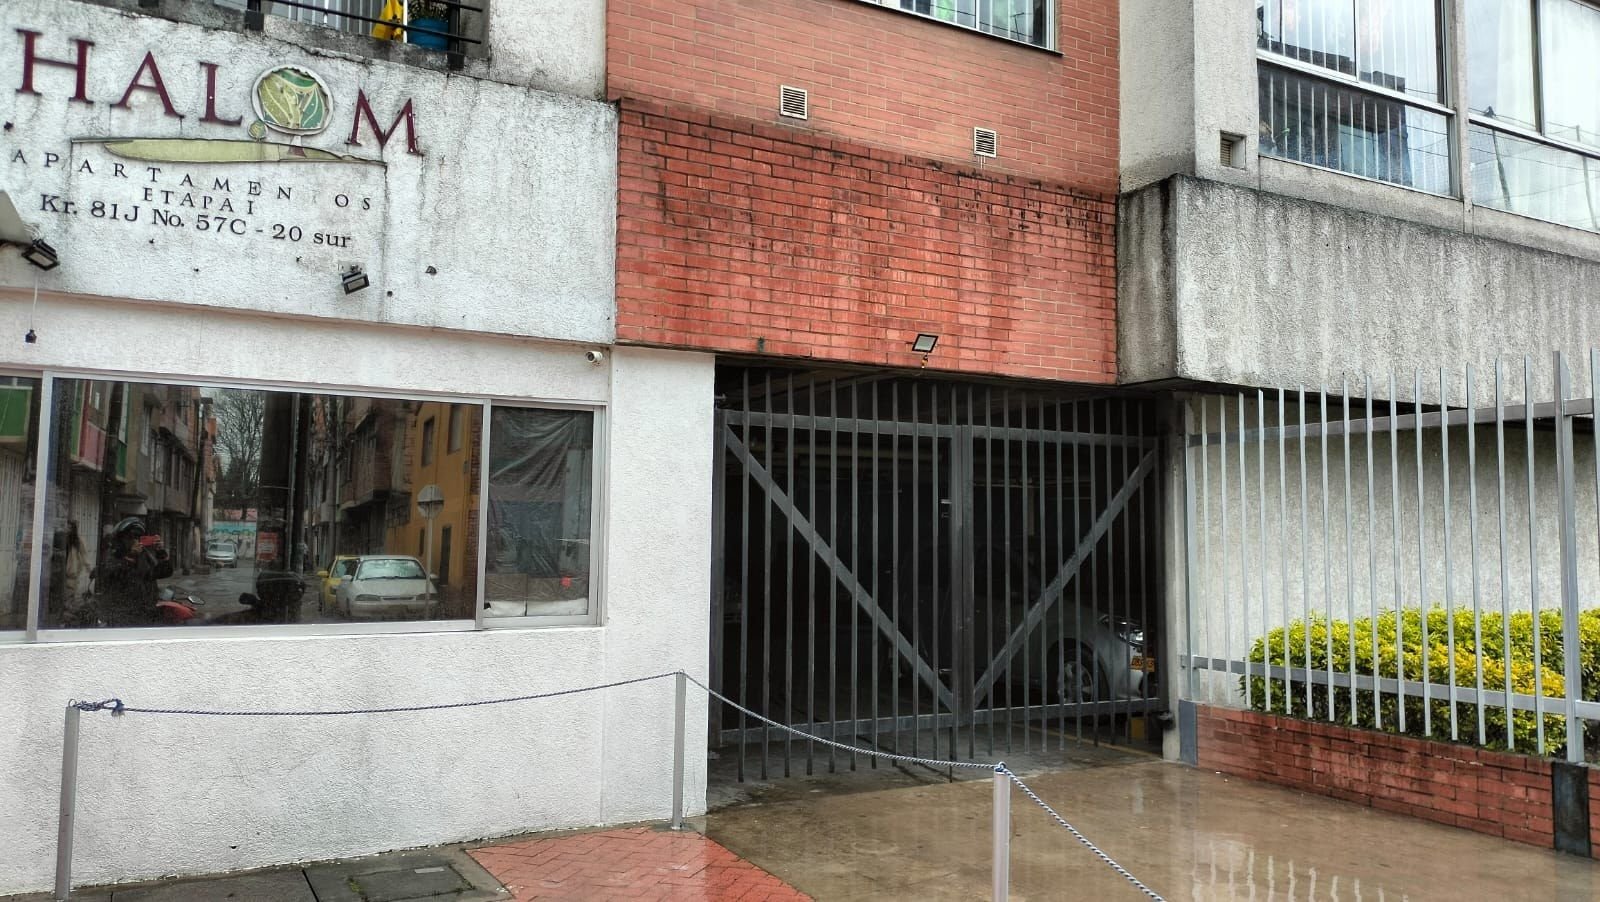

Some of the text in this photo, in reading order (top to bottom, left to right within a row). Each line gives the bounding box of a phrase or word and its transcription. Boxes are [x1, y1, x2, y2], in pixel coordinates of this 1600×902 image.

[143, 186, 234, 213] ETAPA
[40, 194, 78, 215] Kr.
[90, 200, 139, 222] 81J
[152, 208, 185, 228] No.
[196, 214, 247, 236] 57C
[272, 224, 303, 242] 20
[313, 232, 351, 248] sur
